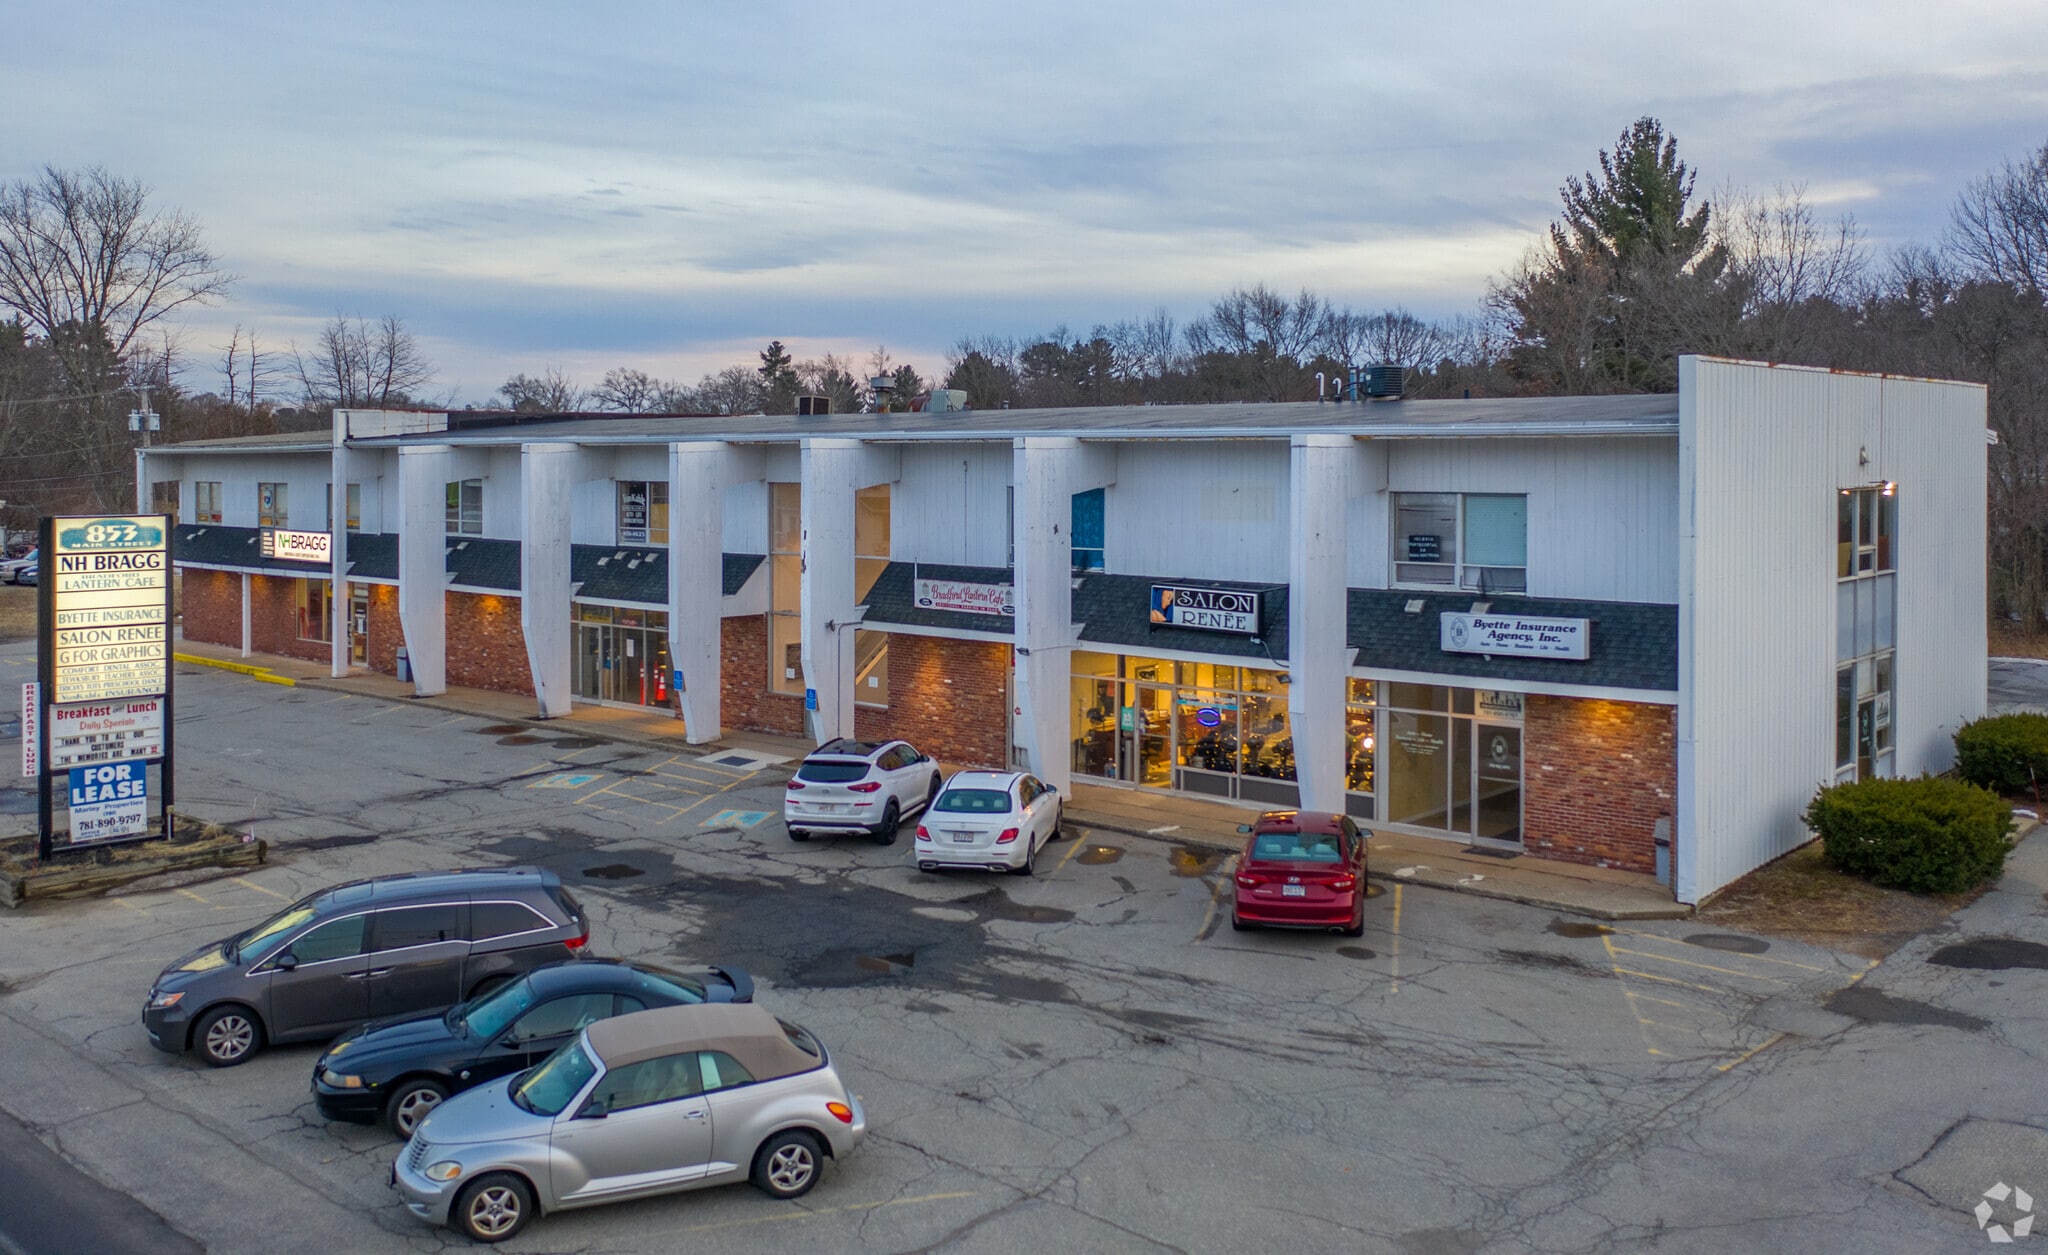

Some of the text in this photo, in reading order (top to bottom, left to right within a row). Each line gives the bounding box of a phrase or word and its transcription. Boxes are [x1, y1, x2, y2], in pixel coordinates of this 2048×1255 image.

[86, 524, 138, 543] 853
[61, 553, 160, 571] NH BRAGG
[65, 577, 155, 590] LANTERN CAFE
[1177, 590, 1252, 612] SALON
[58, 608, 162, 624] BYETTE INSURANCE
[1473, 619, 1577, 634] Byette Insurance
[60, 626, 162, 645] SALON RENEE
[1539, 633, 1561, 643] Inc.
[60, 645, 161, 664] G FOR GRAPHICS
[26, 684, 35, 736] BREAKFAST
[57, 705, 111, 720] Breakfast
[127, 701, 157, 713] Lunch
[80, 721, 101, 731] Daily
[61, 737, 80, 746] THANK
[85, 735, 97, 743] YOU
[133, 730, 144, 738] OUR
[91, 741, 124, 752] CUSTOMERS
[26, 747, 35, 776] LUNCH
[61, 756, 72, 764] THE
[77, 752, 108, 762] MEMORIES
[112, 750, 123, 758] ARE
[130, 747, 147, 755] MANY
[84, 764, 131, 785] FOR
[72, 779, 144, 805] LEASE
[104, 800, 144, 809] Properties
[79, 814, 142, 831] 781-890-9797
